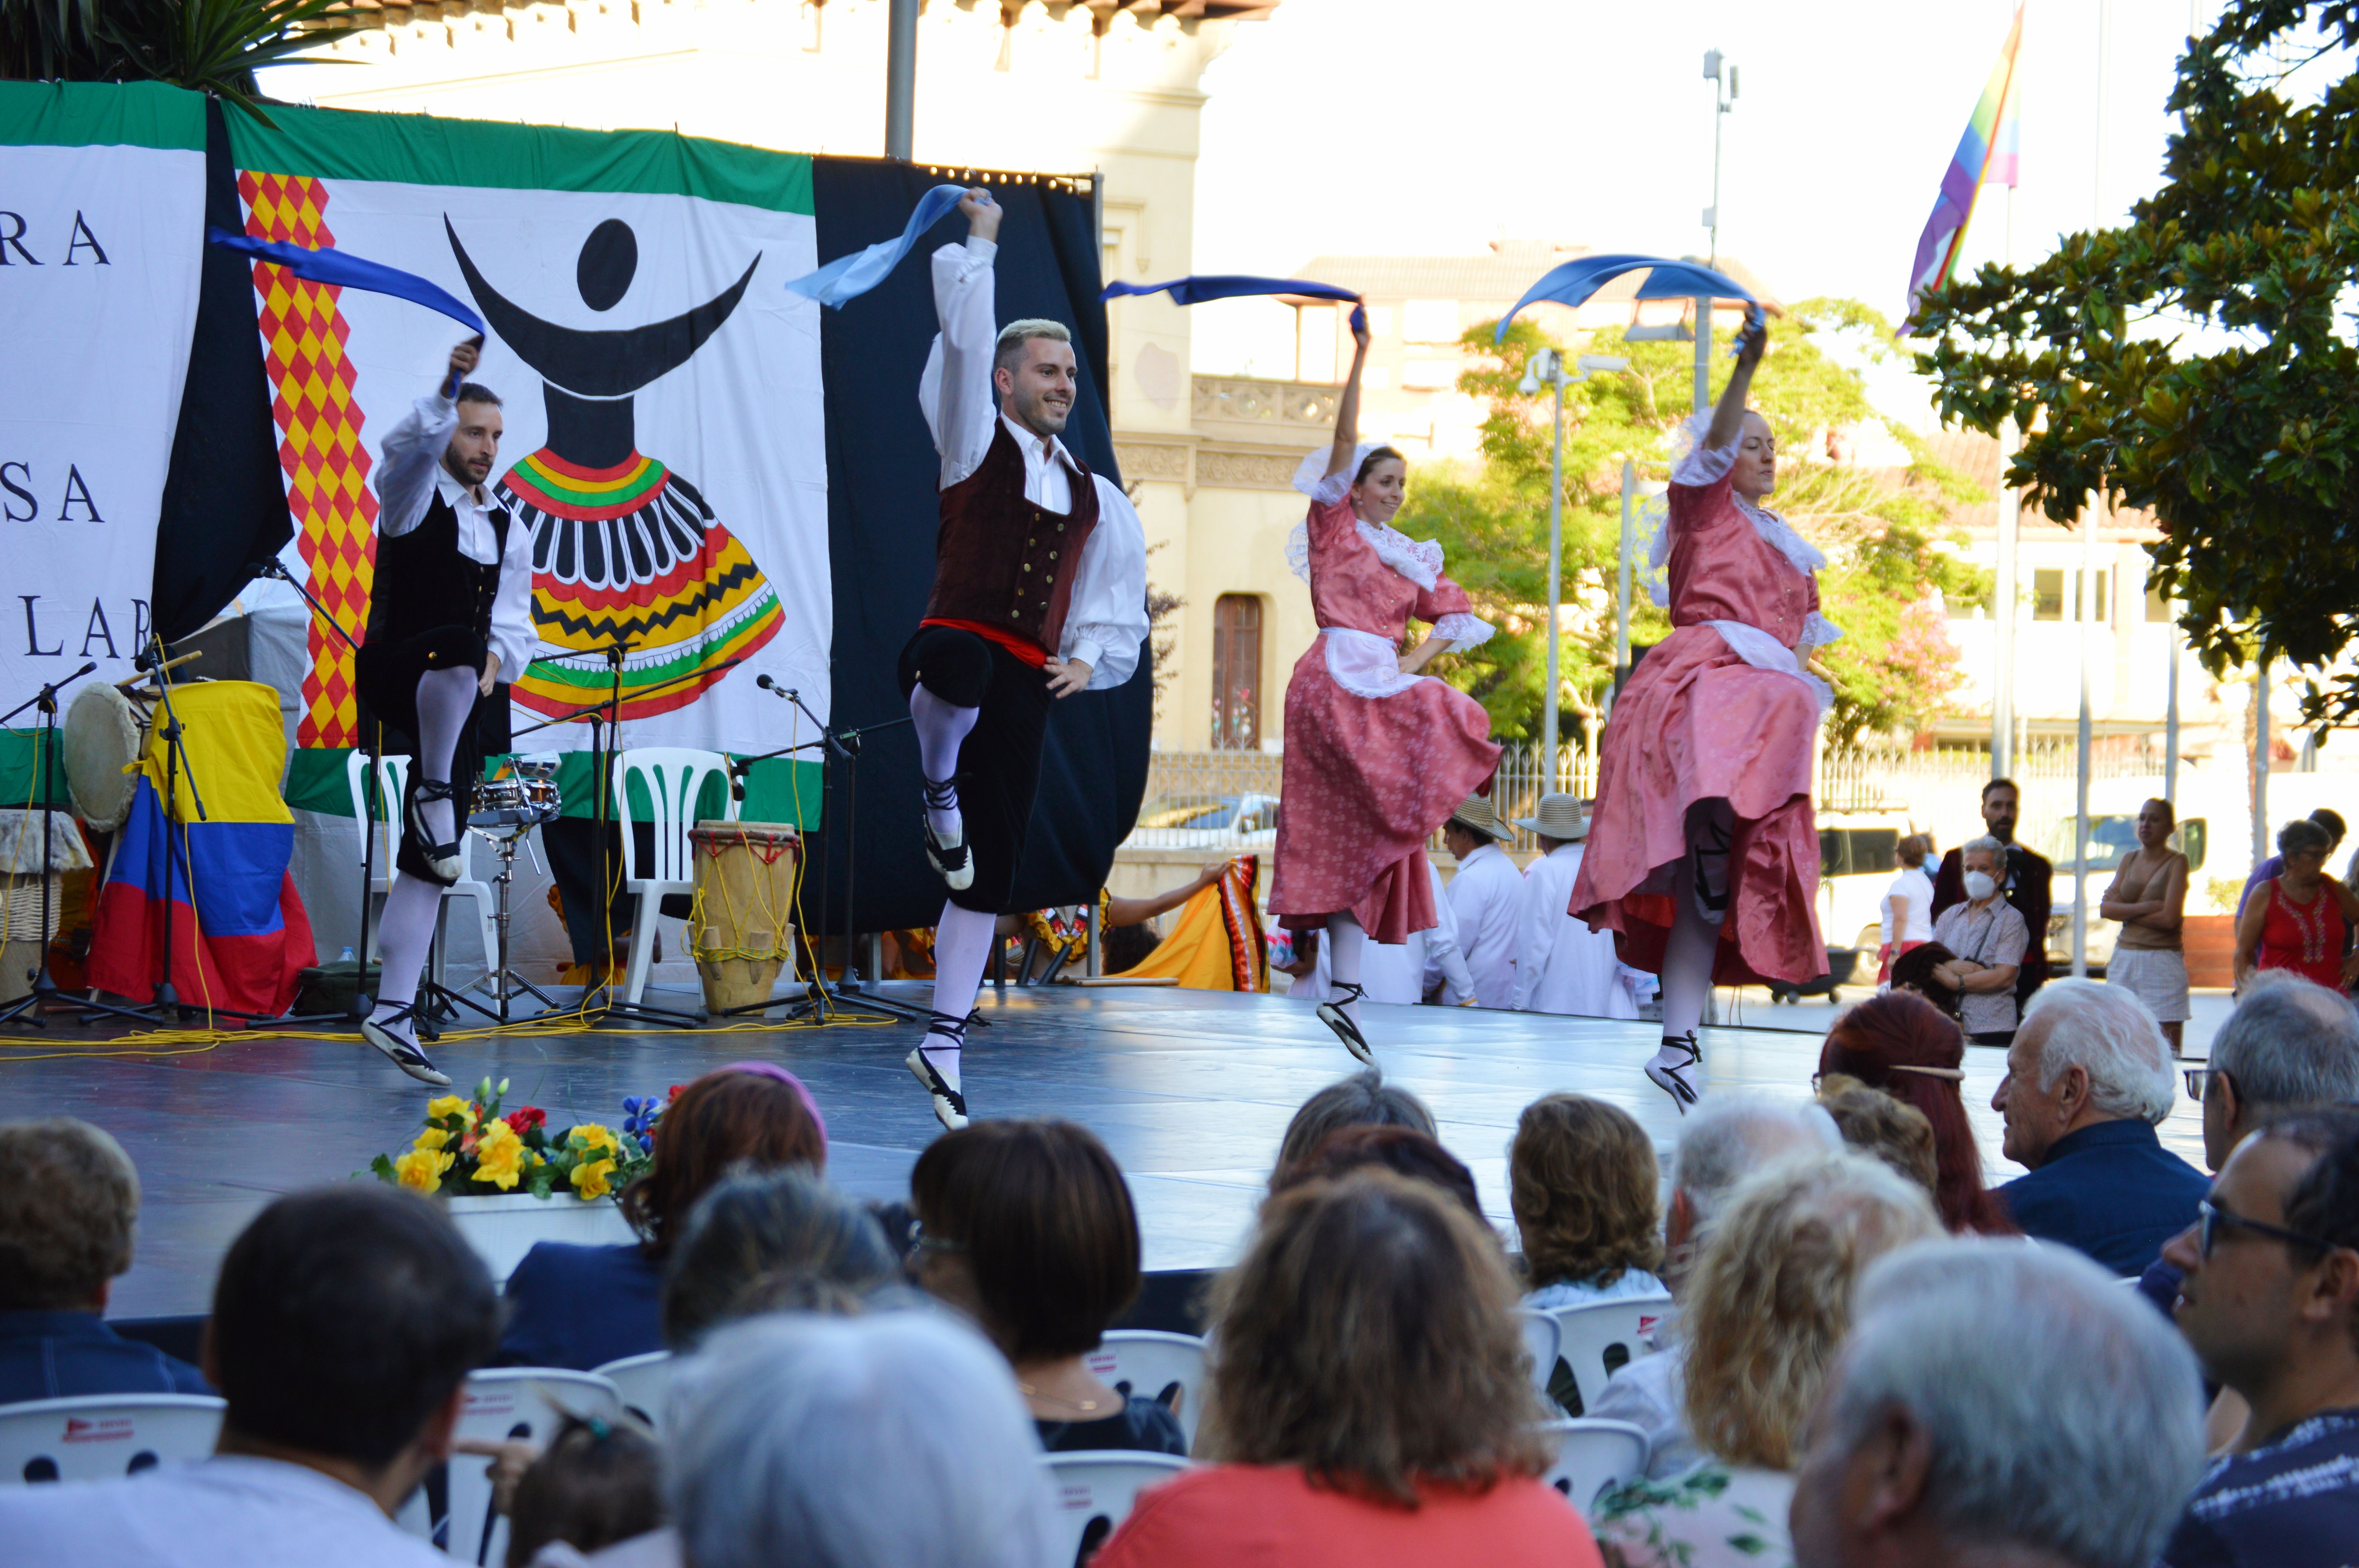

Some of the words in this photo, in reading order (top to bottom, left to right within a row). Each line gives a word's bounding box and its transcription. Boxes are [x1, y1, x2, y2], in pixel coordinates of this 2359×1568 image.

[0, 210, 111, 266] RA
[0, 461, 105, 523] SA
[18, 595, 151, 660] LAR
